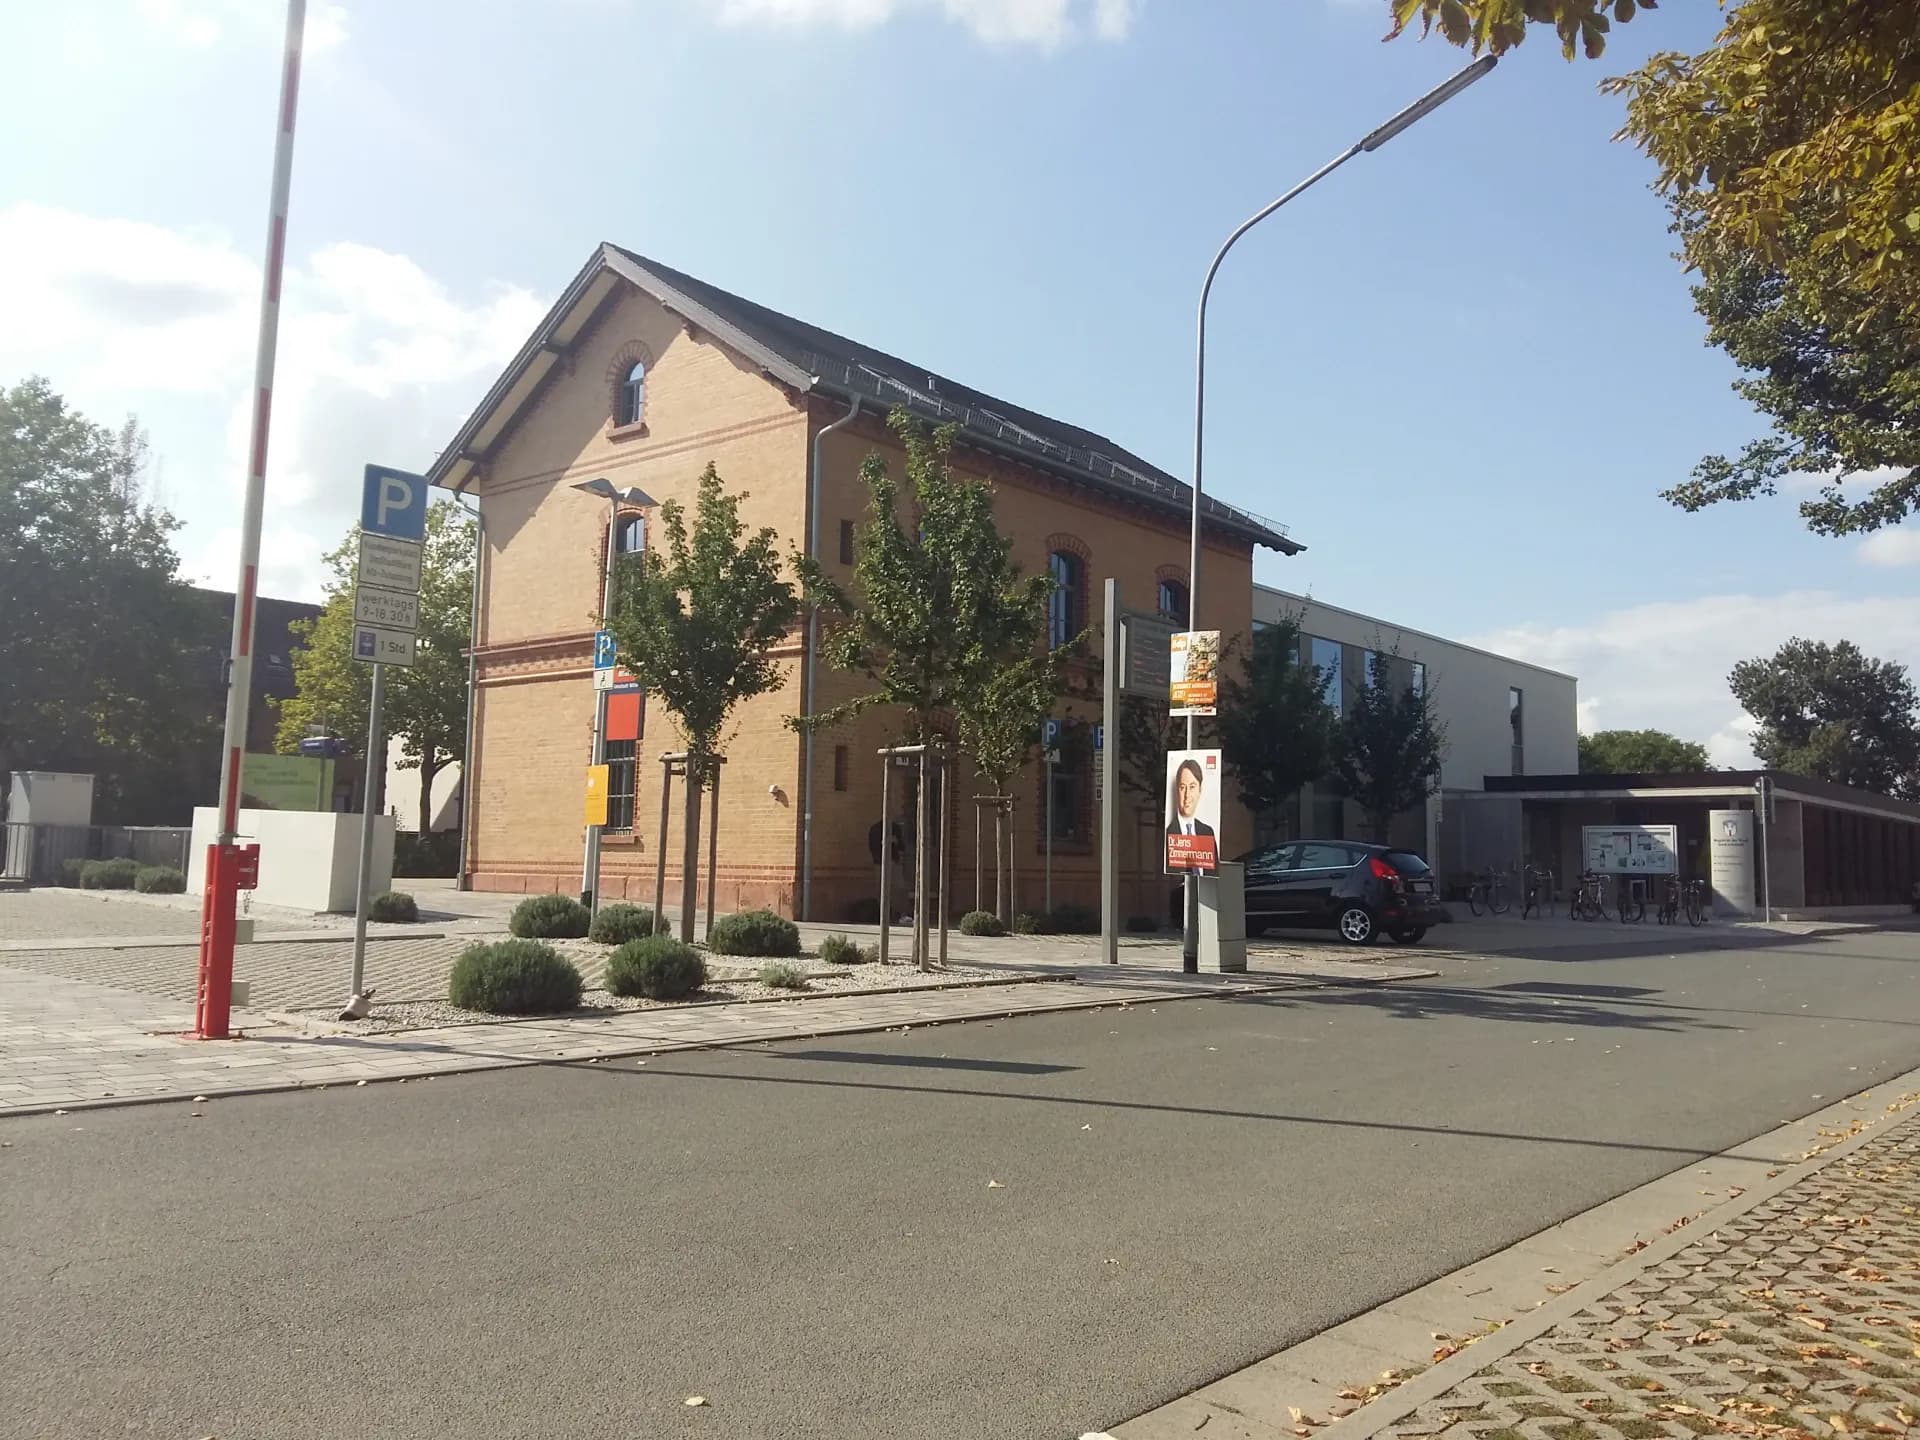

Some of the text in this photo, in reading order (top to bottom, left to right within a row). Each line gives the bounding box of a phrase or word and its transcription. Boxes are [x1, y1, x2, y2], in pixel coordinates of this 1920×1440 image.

[377, 476, 413, 526] P
[361, 595, 413, 612] werktags
[381, 641, 385, 652] 1
[598, 635, 611, 665] P
[1046, 722, 1057, 743] P
[1176, 836, 1192, 848] Jens
[1168, 847, 1213, 860] Zimmermann
